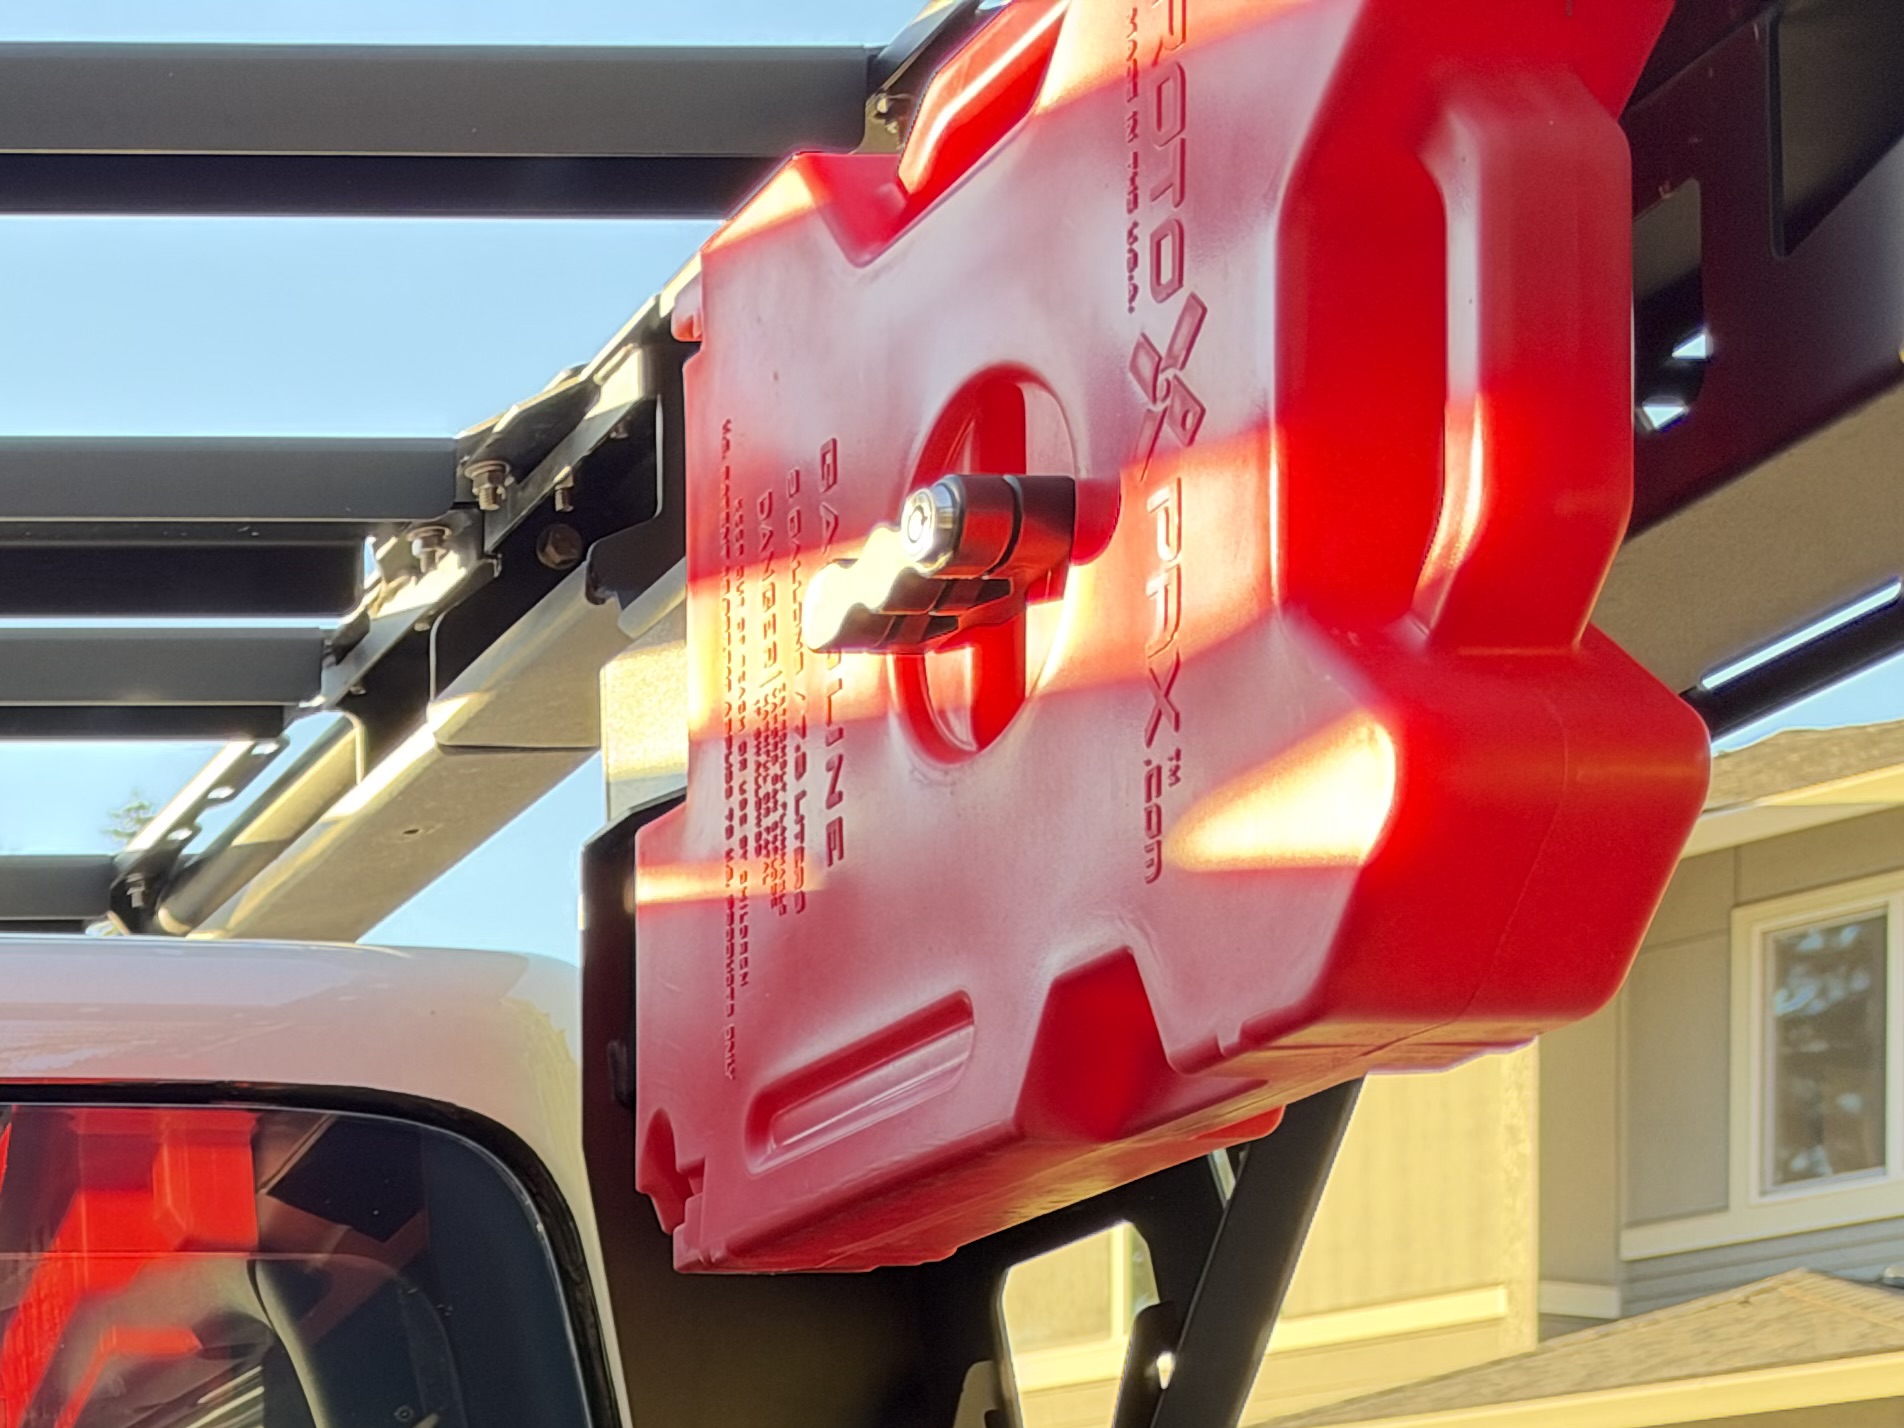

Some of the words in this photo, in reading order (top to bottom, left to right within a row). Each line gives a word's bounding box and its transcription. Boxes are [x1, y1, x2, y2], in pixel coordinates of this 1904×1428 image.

[757, 489, 778, 670] DANGER
[819, 437, 844, 869] GALINE
[1145, 476, 1182, 749] PAX
